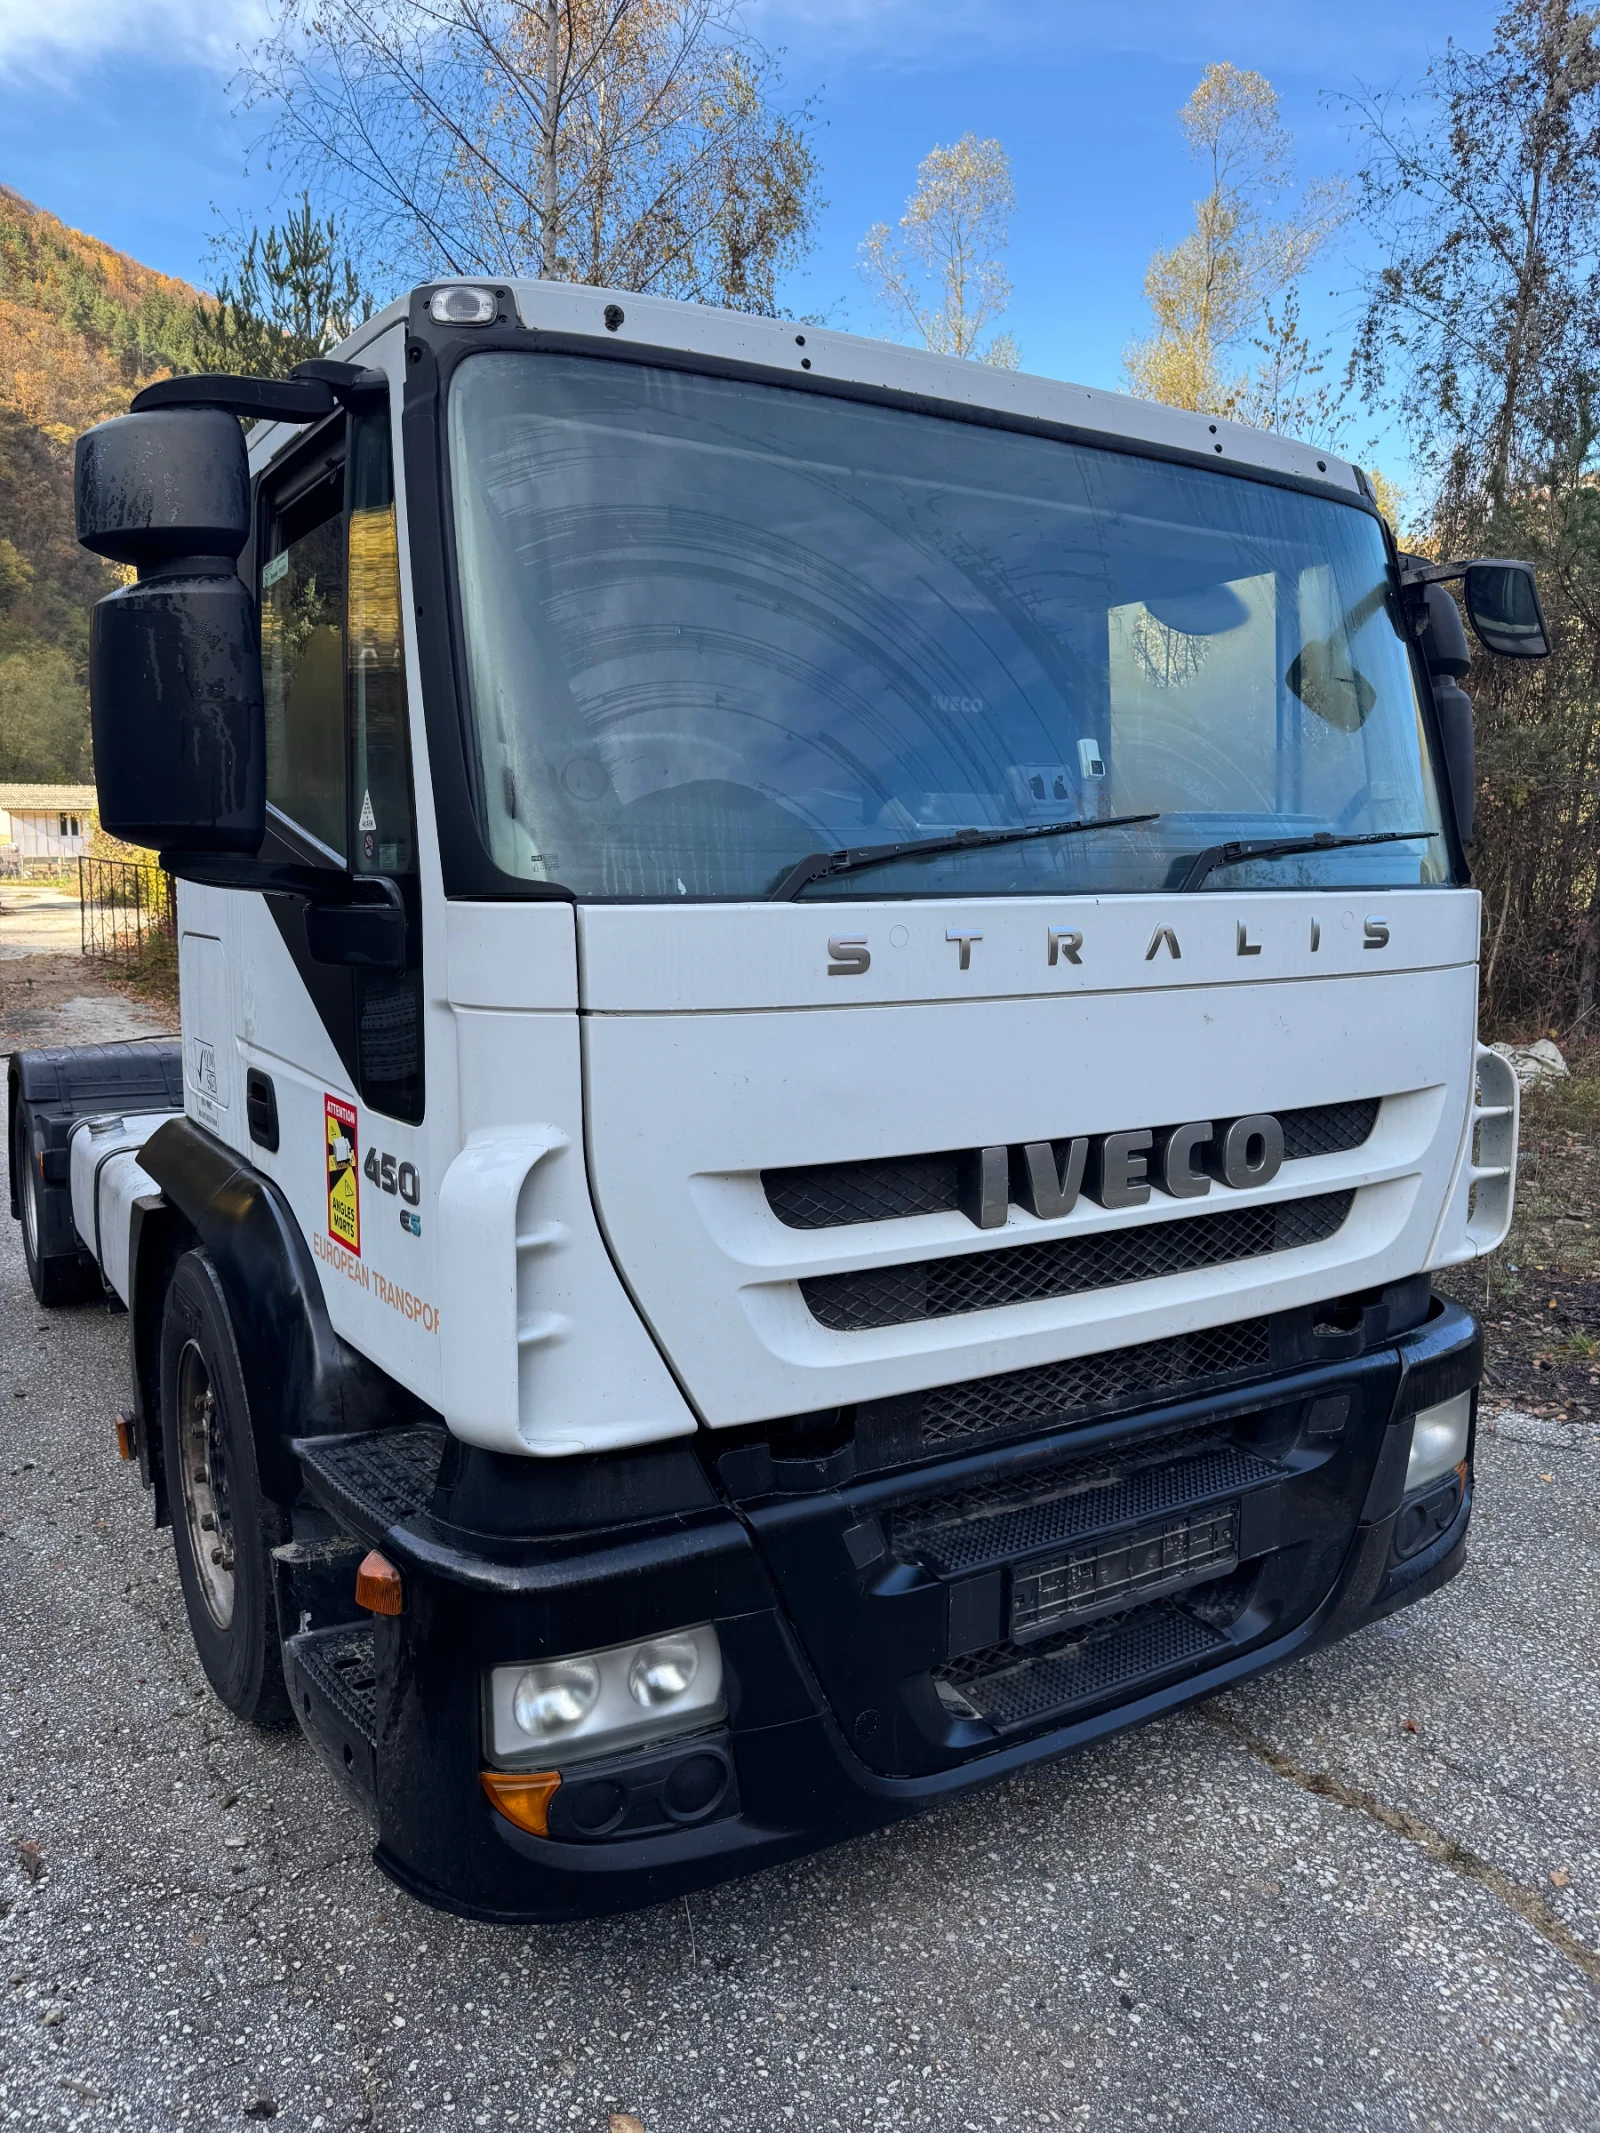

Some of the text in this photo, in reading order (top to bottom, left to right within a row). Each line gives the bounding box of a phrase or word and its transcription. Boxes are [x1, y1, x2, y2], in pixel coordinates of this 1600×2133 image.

[827, 914, 1391, 977] STRALIS
[327, 1100, 355, 1124] ATTENTION
[364, 1146, 421, 1206] 450
[978, 1114, 1285, 1229] IVECO
[332, 1197, 355, 1222] ANGLES
[334, 1212, 355, 1238] MORTS
[313, 1231, 370, 1292] EUROPEAN
